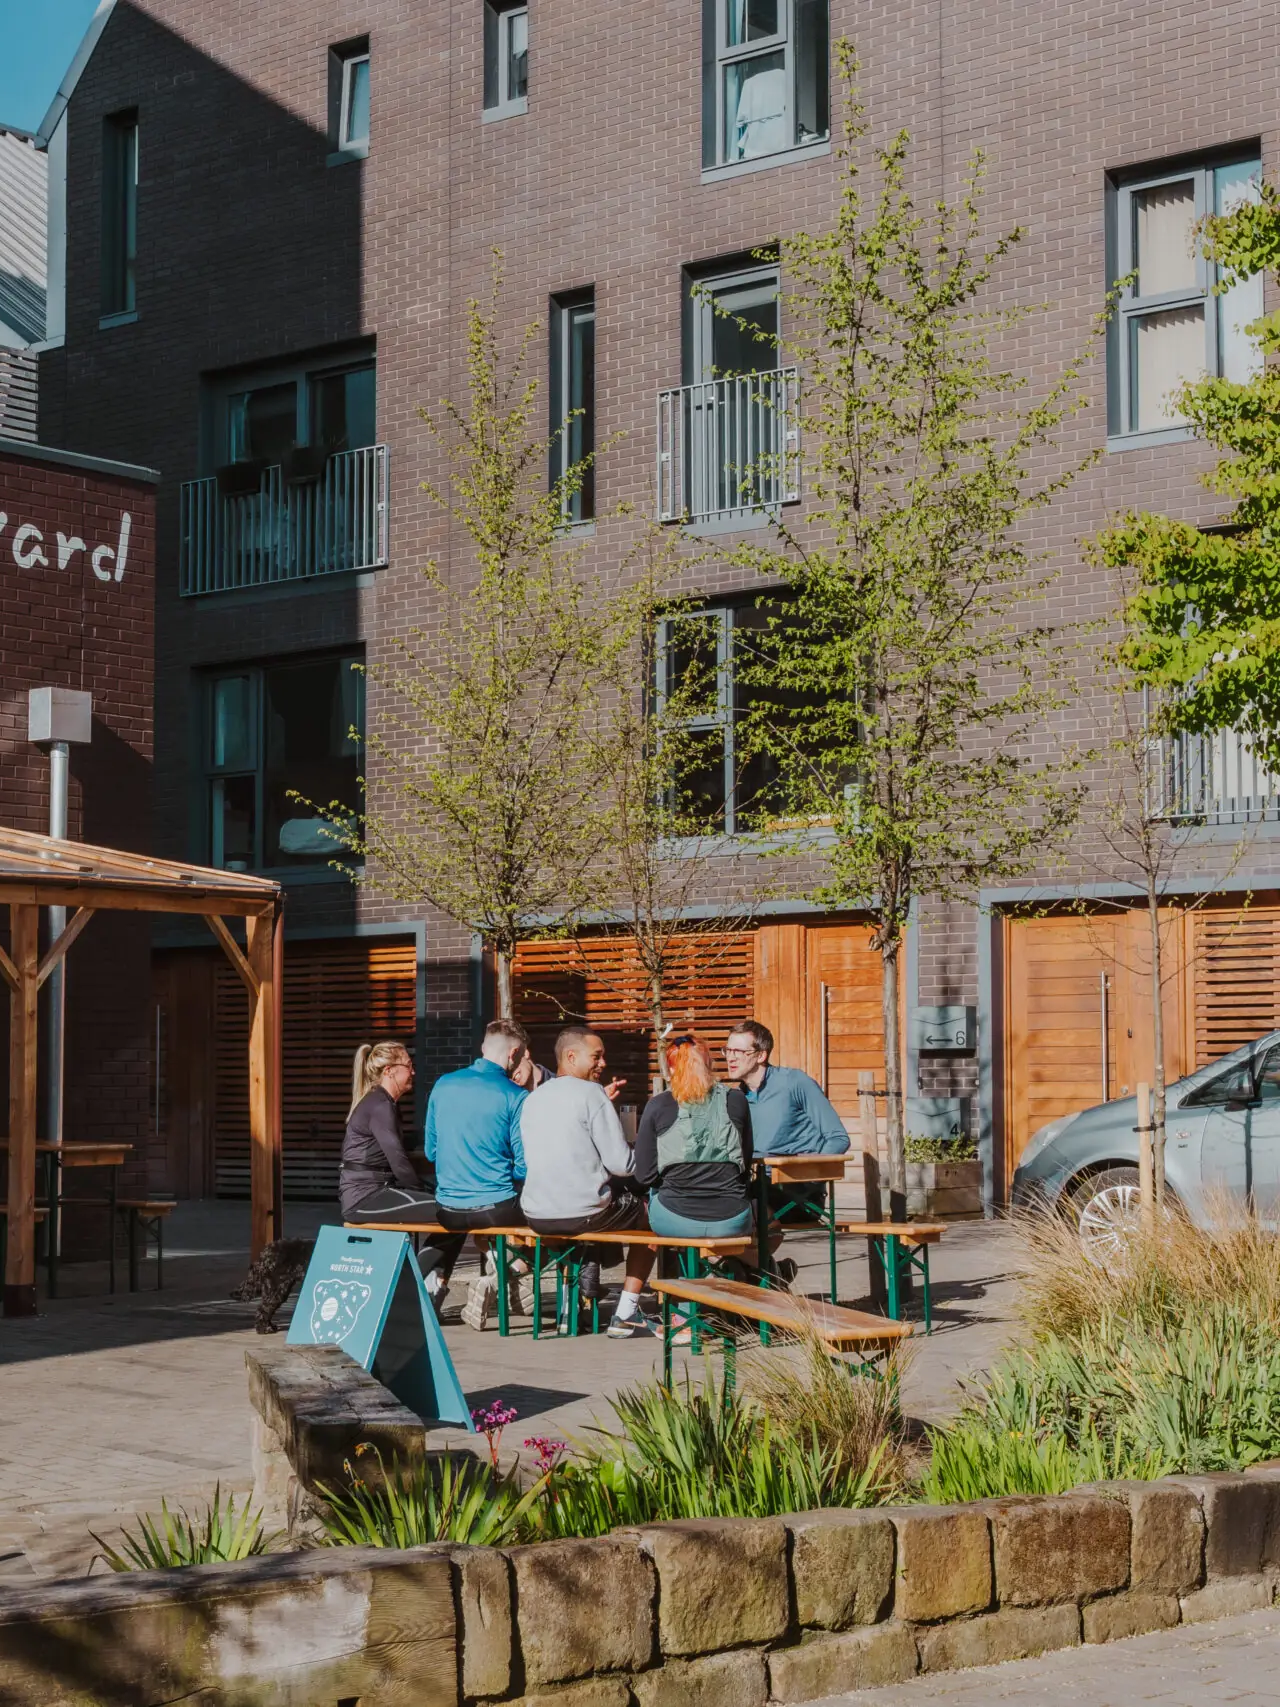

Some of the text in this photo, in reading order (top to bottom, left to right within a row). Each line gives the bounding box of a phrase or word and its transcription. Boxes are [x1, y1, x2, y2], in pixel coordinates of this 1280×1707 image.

[955, 1030, 966, 1046] 6
[950, 1123, 959, 1136] 4
[330, 1263, 365, 1275] NORTH STAR
